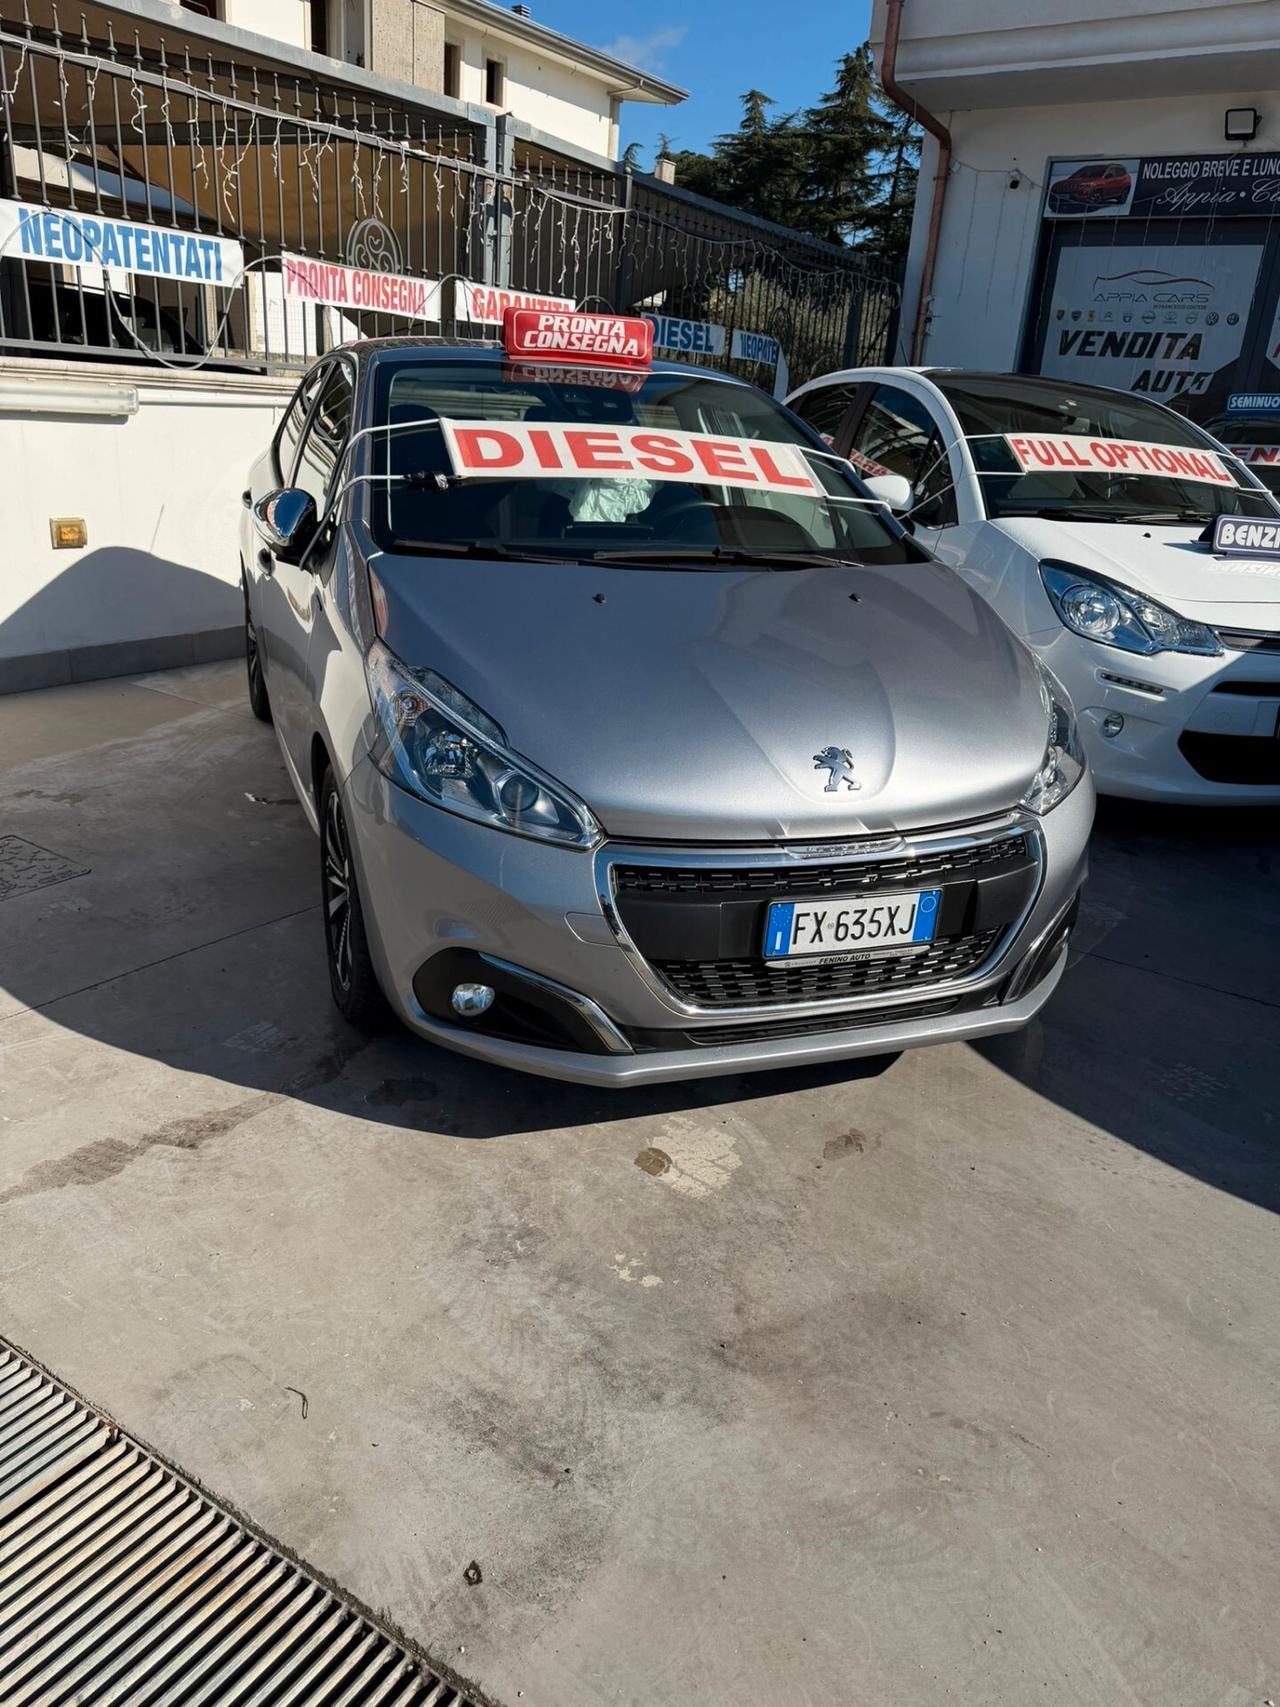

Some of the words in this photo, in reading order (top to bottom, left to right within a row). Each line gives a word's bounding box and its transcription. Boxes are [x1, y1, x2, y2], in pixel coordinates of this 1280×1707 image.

[1143, 161, 1200, 179] NOLEGGIO
[1201, 160, 1241, 178] BREVE
[1242, 159, 1251, 176] E
[1156, 181, 1236, 212] Appia
[18, 208, 223, 281] NEOPATENTATI
[286, 259, 348, 303] PRONTA
[352, 271, 426, 315] CONSEGNA
[1093, 293, 1149, 303] APPIA
[1153, 293, 1211, 303] CARS
[538, 315, 625, 337] PRONTA
[650, 315, 714, 353] DIESEL
[523, 331, 638, 355] CONSEGNA
[1058, 330, 1204, 361] VENDITA
[1130, 370, 1214, 395] AUTO
[453, 428, 814, 489] DIESEL
[1011, 438, 1092, 467] FULL
[1089, 442, 1232, 482] OPTIONAL
[792, 911, 827, 945] FX
[834, 904, 916, 942] 635XJ
[819, 956, 849, 965] FENINO
[849, 953, 871, 961] AUTO
